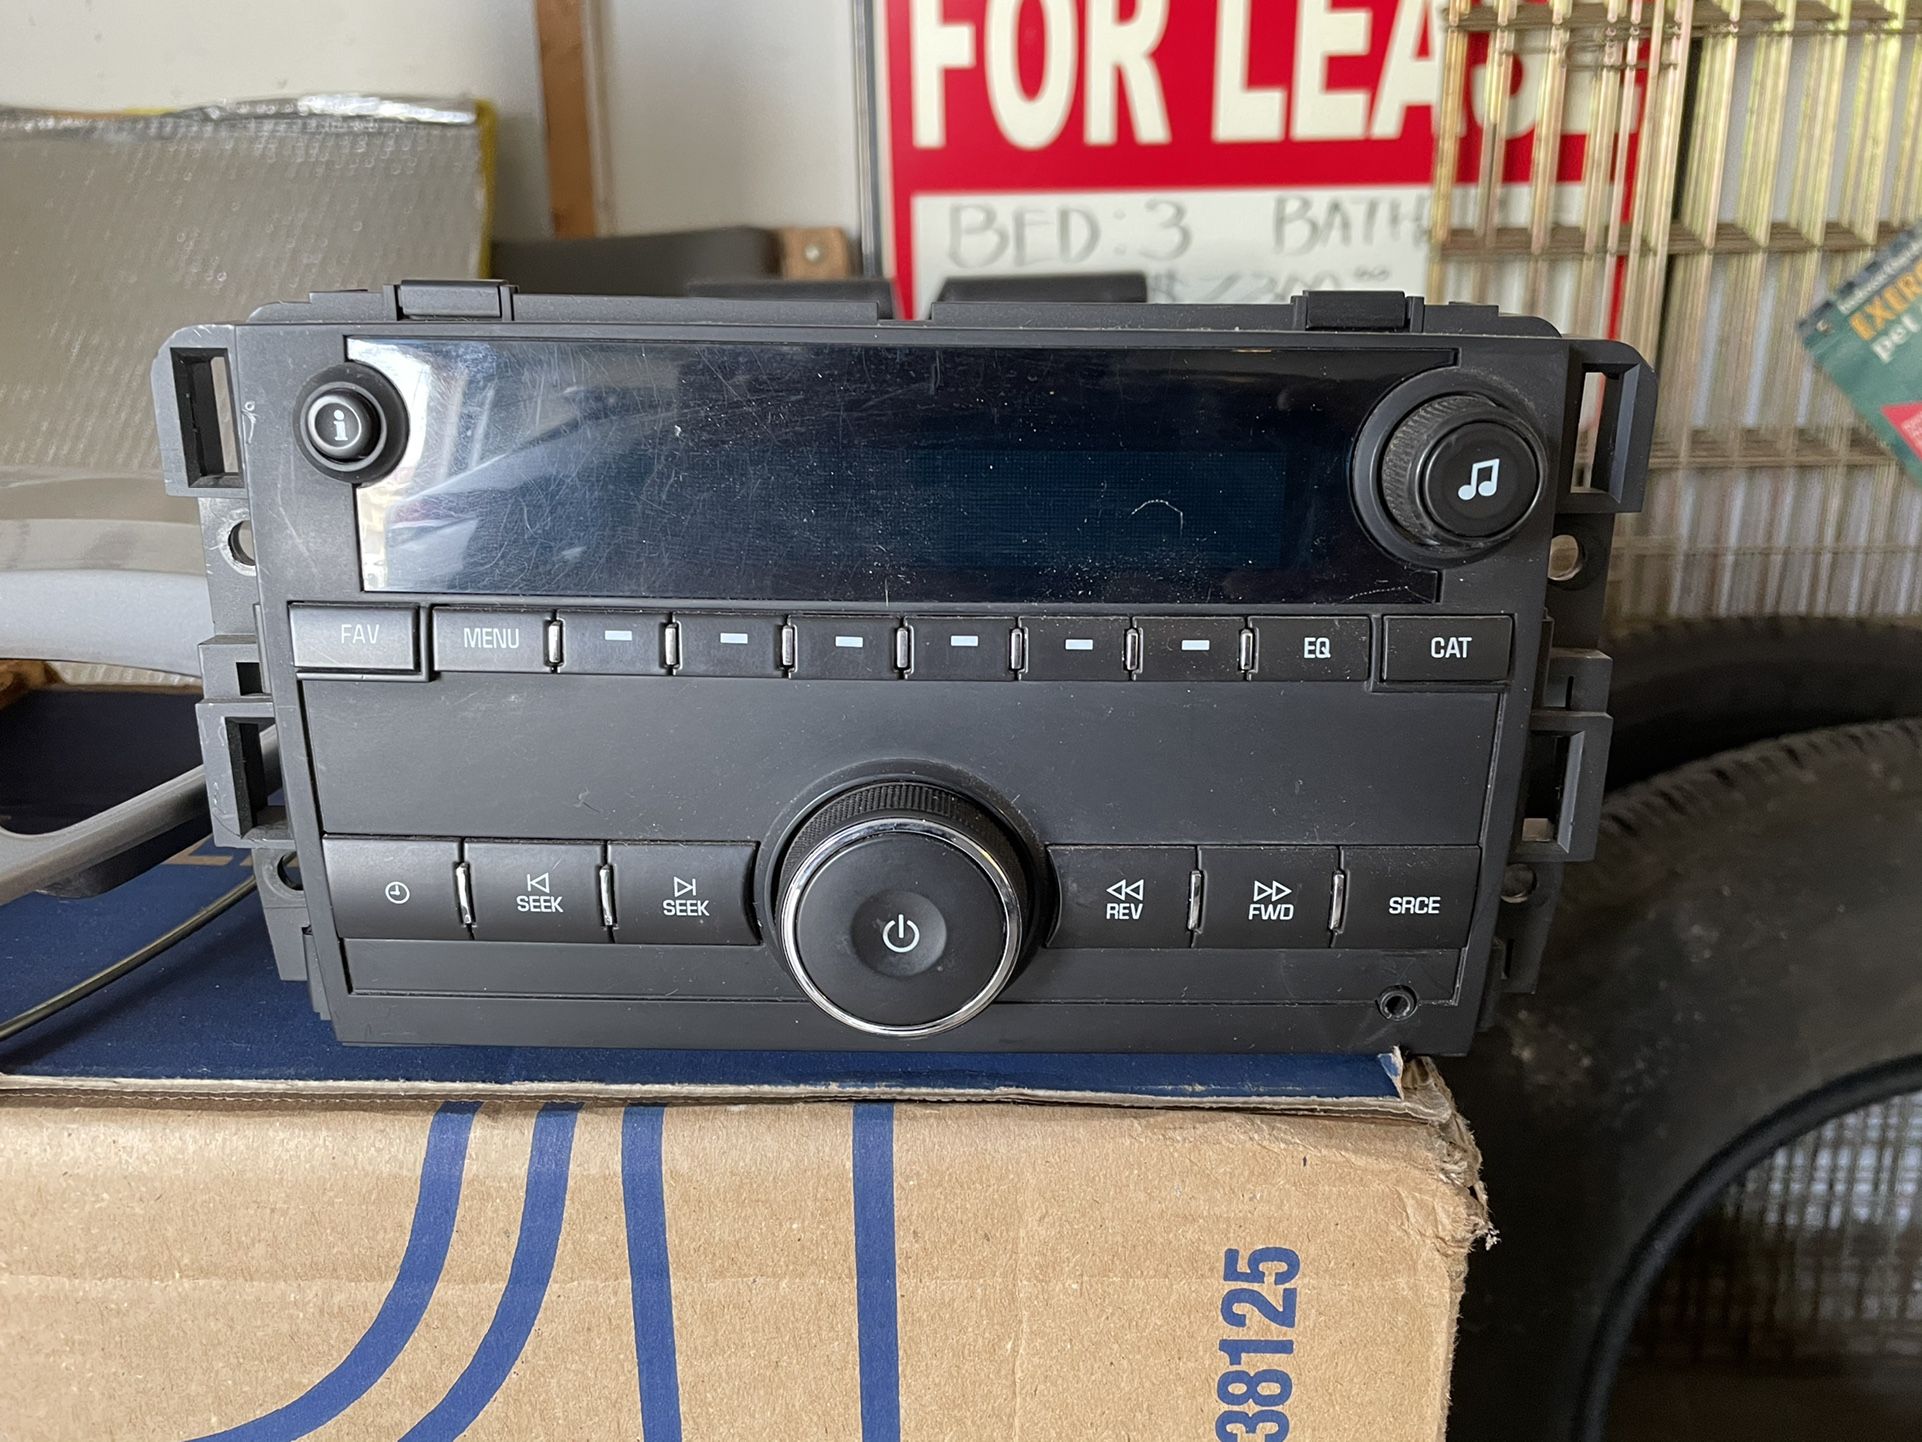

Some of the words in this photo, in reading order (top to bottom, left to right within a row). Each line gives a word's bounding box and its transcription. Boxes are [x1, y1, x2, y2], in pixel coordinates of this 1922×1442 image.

[912, 0, 1172, 149] FOR
[1139, 199, 1193, 261] 3
[340, 623, 380, 645] FAV
[463, 627, 520, 649] MENU
[1303, 636, 1332, 659] EQ
[1430, 636, 1473, 659] CAT
[516, 895, 564, 913] SEEK
[662, 899, 710, 917] SEEK
[1105, 902, 1144, 920] REV
[1248, 903, 1295, 921] FWD
[1388, 896, 1442, 915] SRCE
